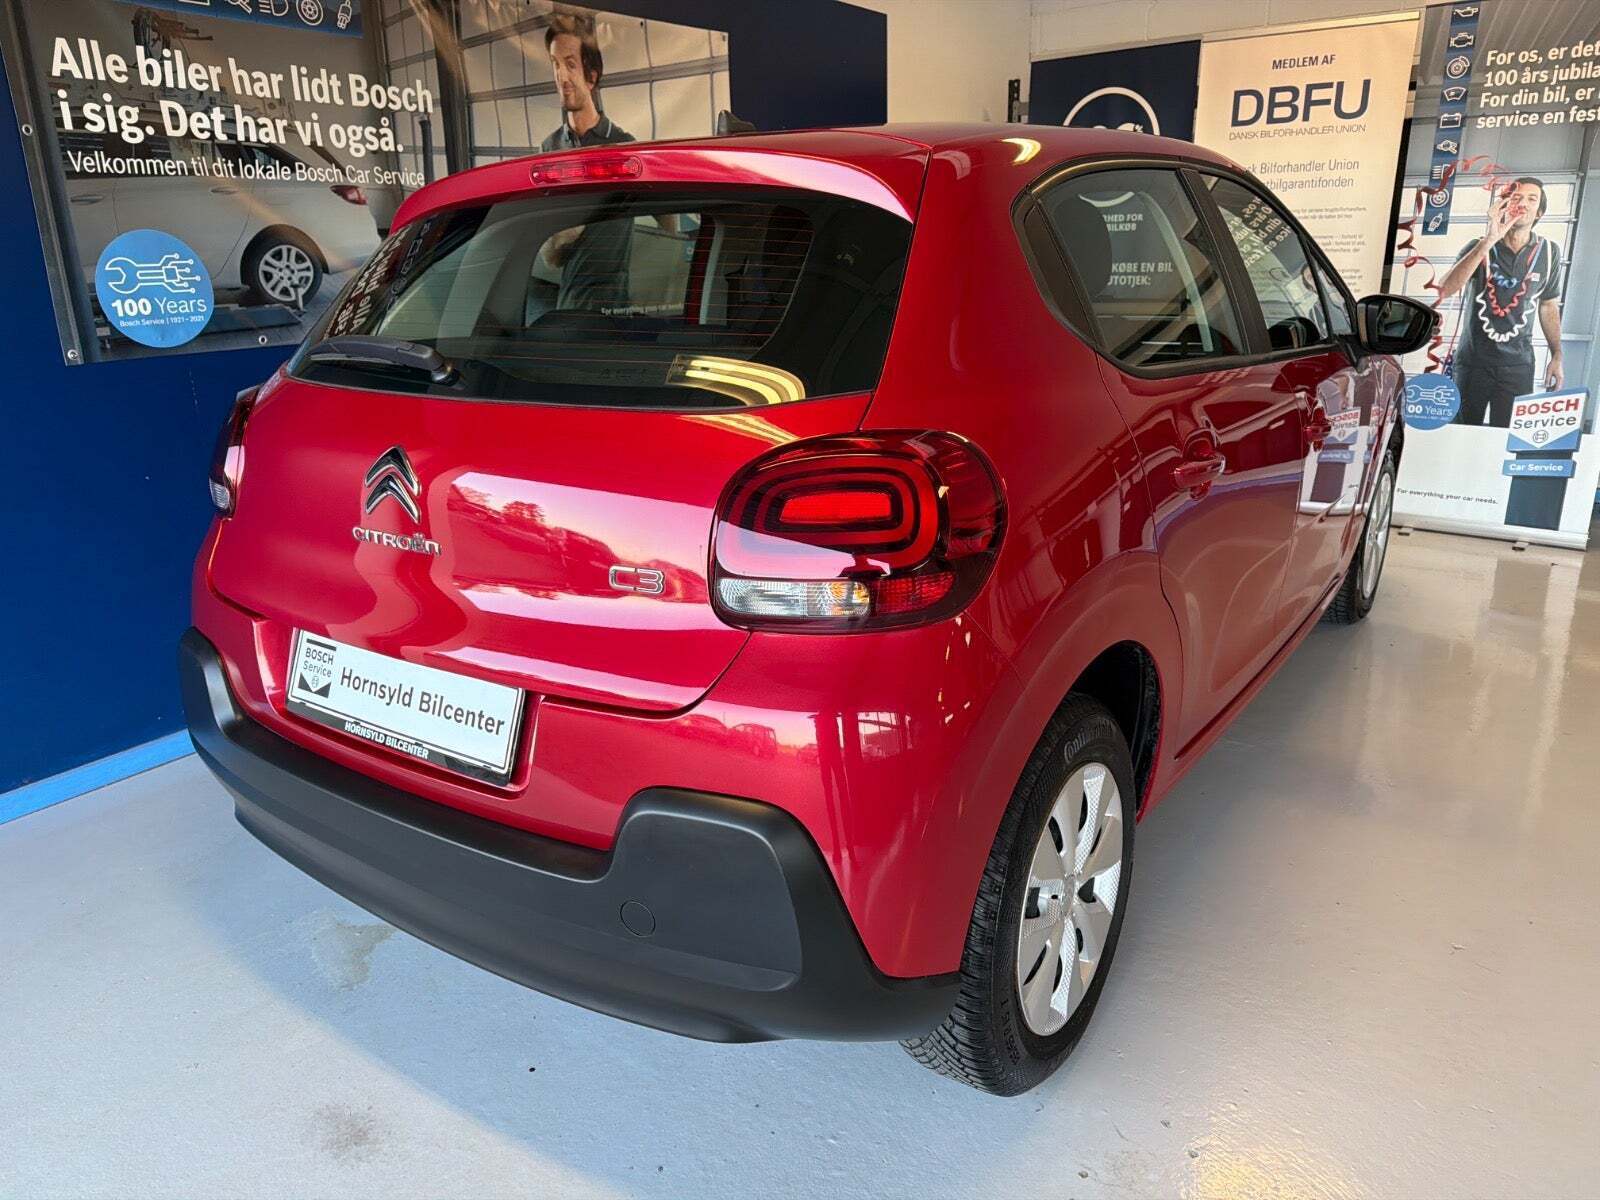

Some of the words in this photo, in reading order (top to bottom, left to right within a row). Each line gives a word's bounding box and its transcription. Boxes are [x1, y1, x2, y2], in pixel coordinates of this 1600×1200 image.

[1272, 56, 1319, 71] MEDLEM
[1321, 54, 1336, 67] AF
[1485, 49, 1516, 67] For
[1519, 48, 1543, 65] os,
[1547, 46, 1568, 62] er
[1571, 40, 1600, 59] det
[52, 37, 128, 84] Alle
[137, 47, 223, 93] biler
[228, 57, 283, 100] har
[292, 64, 342, 106] lidt
[350, 73, 433, 114] Bosch
[1483, 70, 1518, 88] 100
[1522, 66, 1548, 85] års
[1231, 78, 1373, 128] DBFU
[1480, 91, 1509, 109] For
[1511, 87, 1539, 107] din
[1542, 85, 1571, 105] bil,
[1575, 87, 1595, 102] er
[57, 89, 73, 131] i
[85, 93, 155, 144] sig.
[161, 100, 227, 141] Det
[235, 106, 288, 146] har
[295, 112, 322, 147] vi
[330, 119, 403, 158] også.
[1475, 109, 1538, 129] service
[1543, 110, 1565, 125] en
[1568, 105, 1600, 123] fest
[1229, 130, 1259, 141] DANSK
[1259, 125, 1335, 140] BILFORHANDLER
[1336, 123, 1367, 135] UNION
[67, 151, 187, 178] Velkommen
[191, 155, 209, 178] til
[214, 157, 236, 179] dit
[240, 159, 291, 182] lokale
[296, 164, 342, 184] Bosch
[346, 166, 370, 186] Car
[374, 168, 426, 188] Service
[1260, 160, 1326, 176] Bilforhandler
[1328, 159, 1360, 173] Union
[1265, 176, 1355, 192] tbilgarantifonden
[1141, 262, 1155, 273] EN
[1157, 262, 1173, 273] BIL
[111, 297, 152, 318] 100
[154, 297, 208, 315] Years
[119, 319, 141, 328] Bosch
[141, 318, 164, 327] Service
[1424, 404, 1453, 418] Years
[1514, 397, 1579, 417] BOSCH
[1512, 414, 1577, 430] Service
[1508, 463, 1526, 472] Car
[1527, 462, 1563, 472] Service
[1396, 487, 1408, 495] For
[1409, 489, 1444, 499] everything
[608, 564, 666, 595] C3
[304, 647, 334, 666] BOSCH
[302, 660, 332, 679] Service
[340, 666, 413, 710] Hornsyld
[418, 690, 506, 736] Bilcenter
[344, 720, 385, 744] HORNSYLD
[385, 732, 429, 760] BILCENTER
